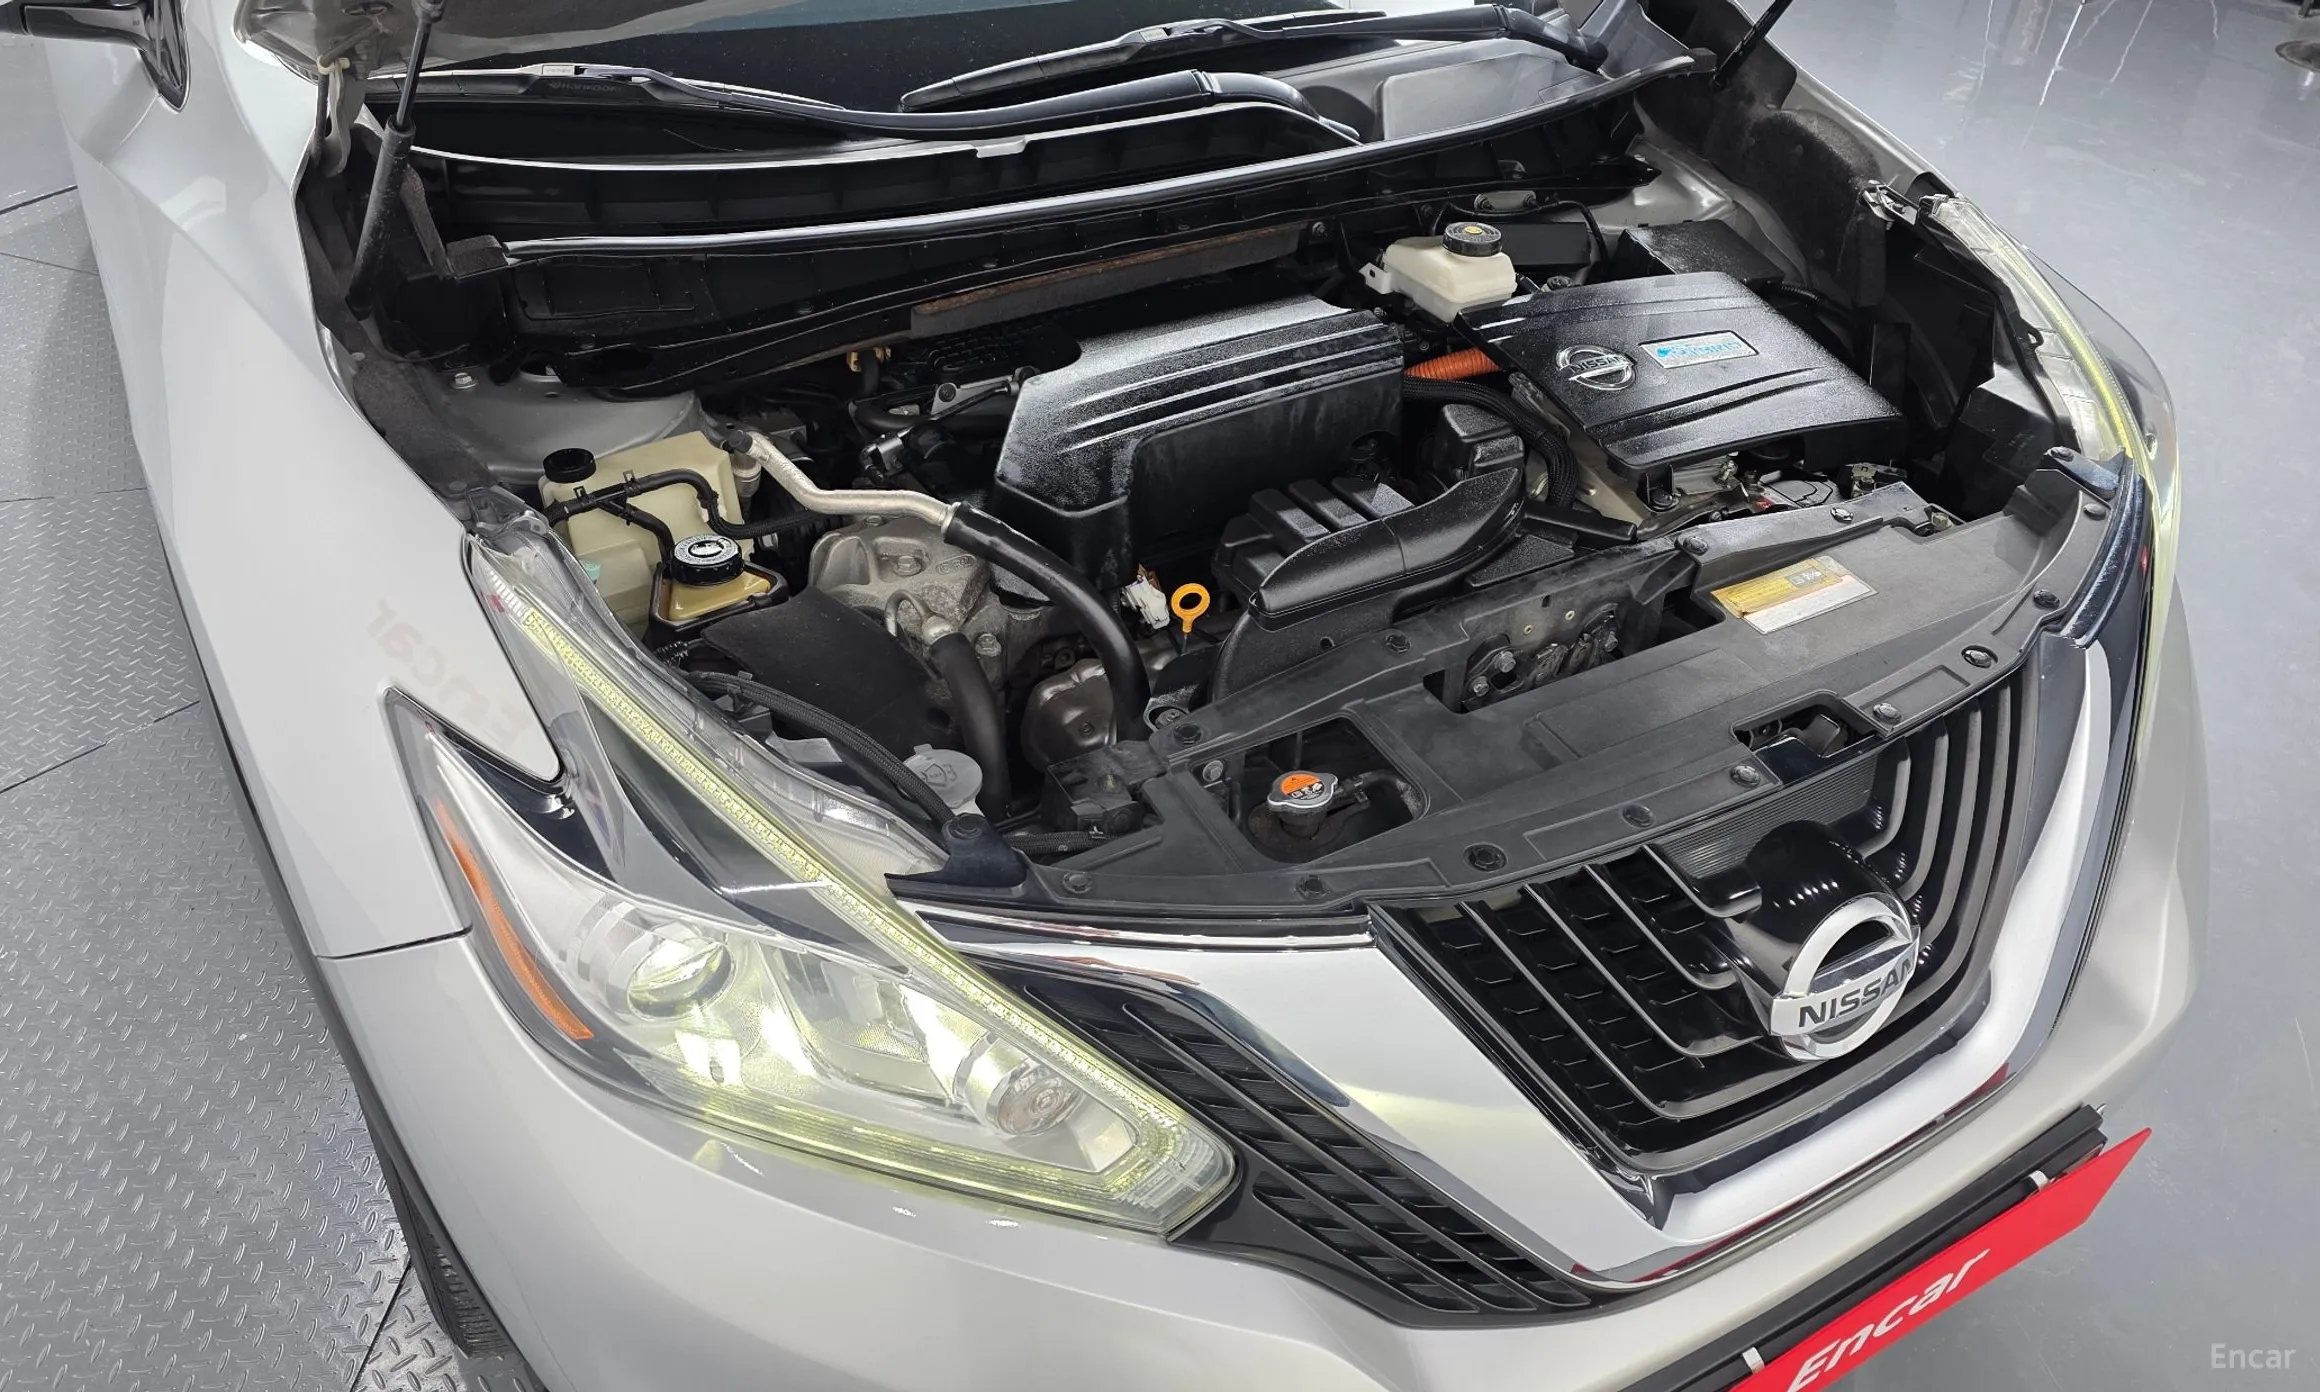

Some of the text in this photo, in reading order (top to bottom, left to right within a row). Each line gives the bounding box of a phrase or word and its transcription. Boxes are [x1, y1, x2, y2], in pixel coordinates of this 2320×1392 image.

[1570, 355, 1629, 374] NISSAN
[1799, 958, 1911, 1028] NISSAN
[1787, 1248, 1991, 1392] Encar
